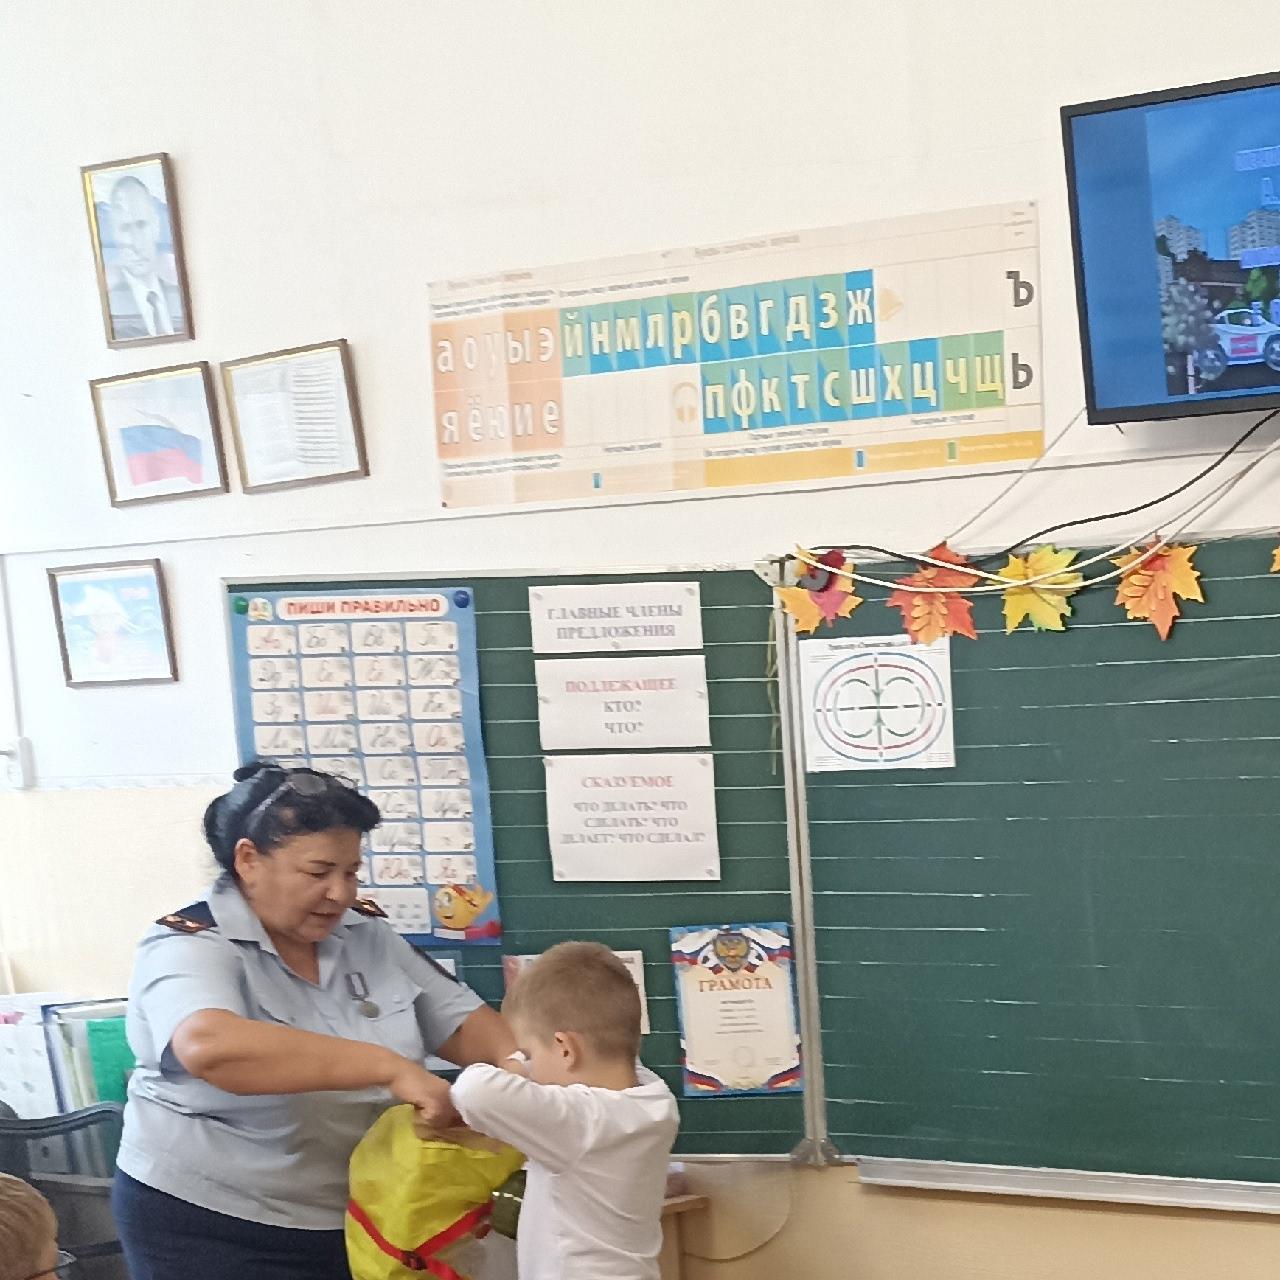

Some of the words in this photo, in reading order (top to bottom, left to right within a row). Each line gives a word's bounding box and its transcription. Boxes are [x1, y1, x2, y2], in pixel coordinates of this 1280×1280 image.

[287, 601, 336, 615] ПИШИ
[340, 598, 440, 614] ПРАВИЛЬНО
[547, 607, 621, 620] ГЛАВНЫЕ
[625, 604, 683, 619] ЧЛЕНЫ
[557, 625, 675, 639] ПРЕДЛОЖЕНИЯ
[565, 678, 676, 693] ПОДЛЕЖАЩЕЕ
[604, 700, 642, 712] КТО?
[604, 722, 644, 734] ЧТО?
[581, 776, 673, 788] СКАЗУЕМОЕ
[698, 976, 773, 993] ГРАМОТА
